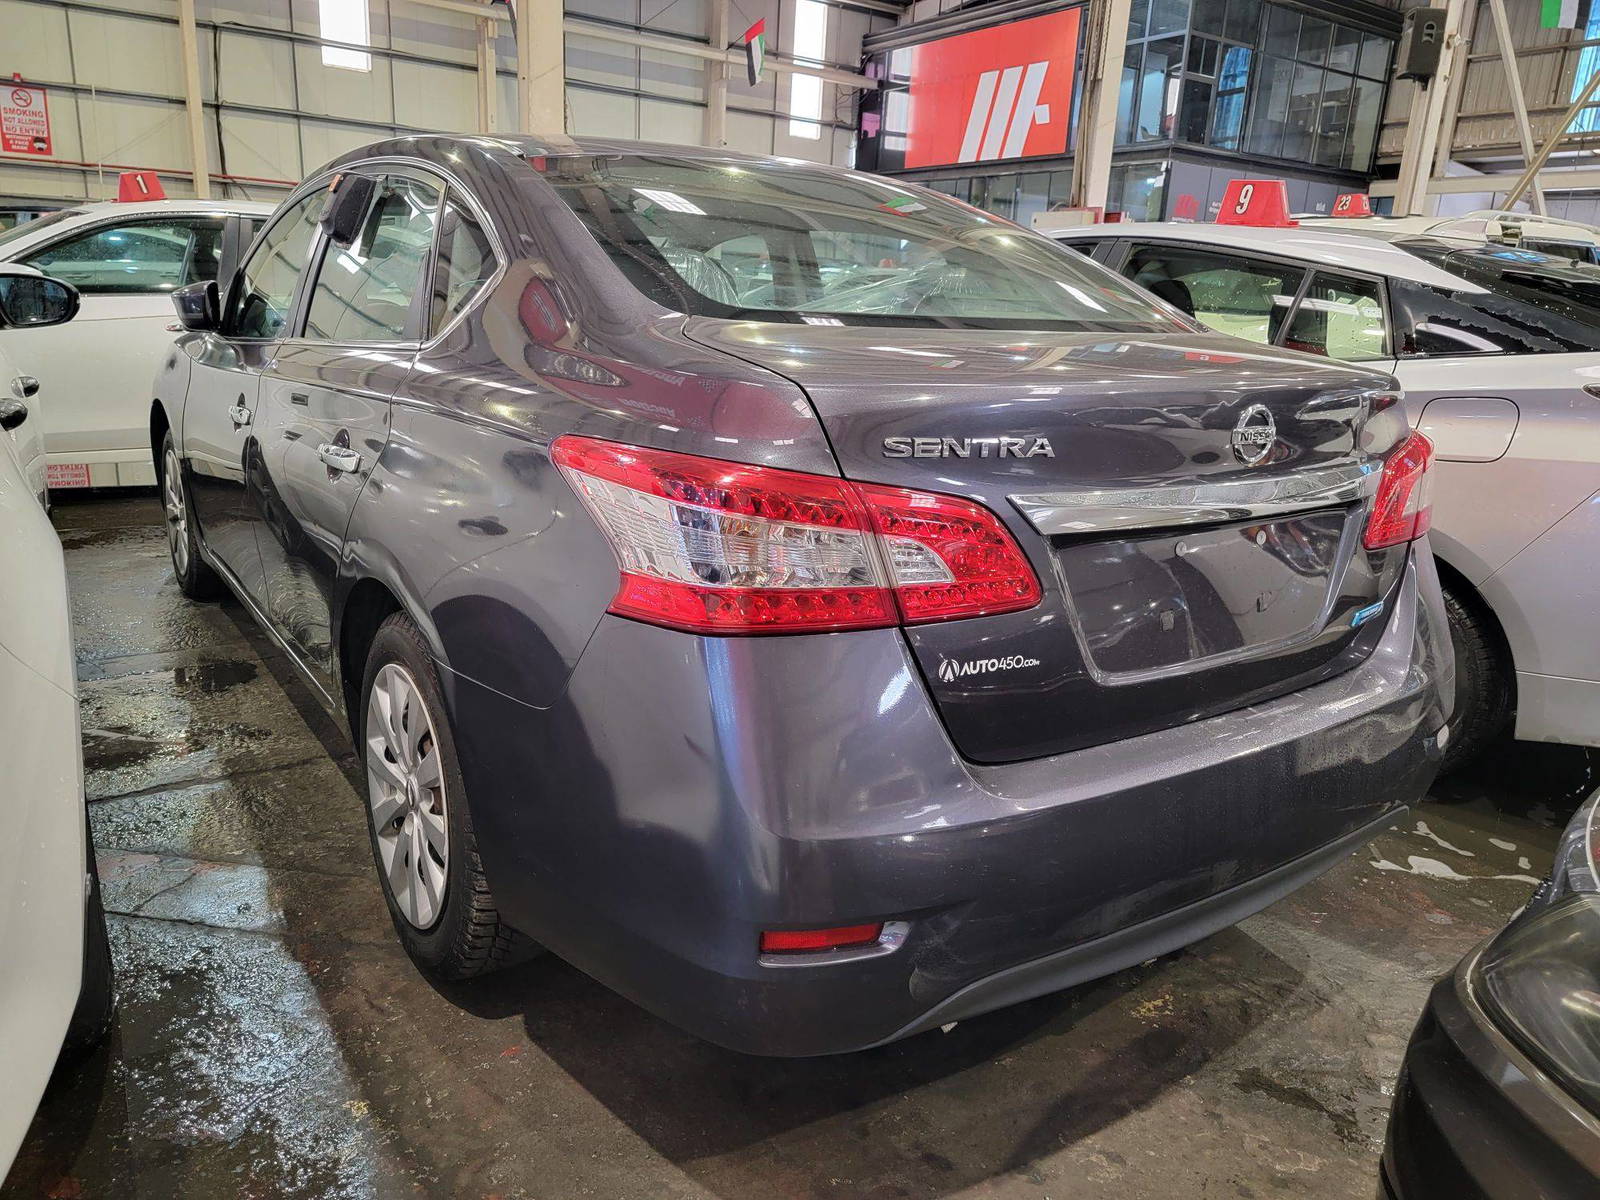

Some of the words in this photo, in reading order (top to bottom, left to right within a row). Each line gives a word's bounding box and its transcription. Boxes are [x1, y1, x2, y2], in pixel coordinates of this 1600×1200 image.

[3, 107, 43, 118] SMOKING
[5, 126, 17, 134] NO
[20, 127, 46, 137] ENTRY
[136, 174, 148, 193] 1
[1236, 184, 1254, 215] 9
[1337, 194, 1352, 211] 23
[1240, 431, 1270, 442] NISS
[882, 436, 1056, 459] SENTRA
